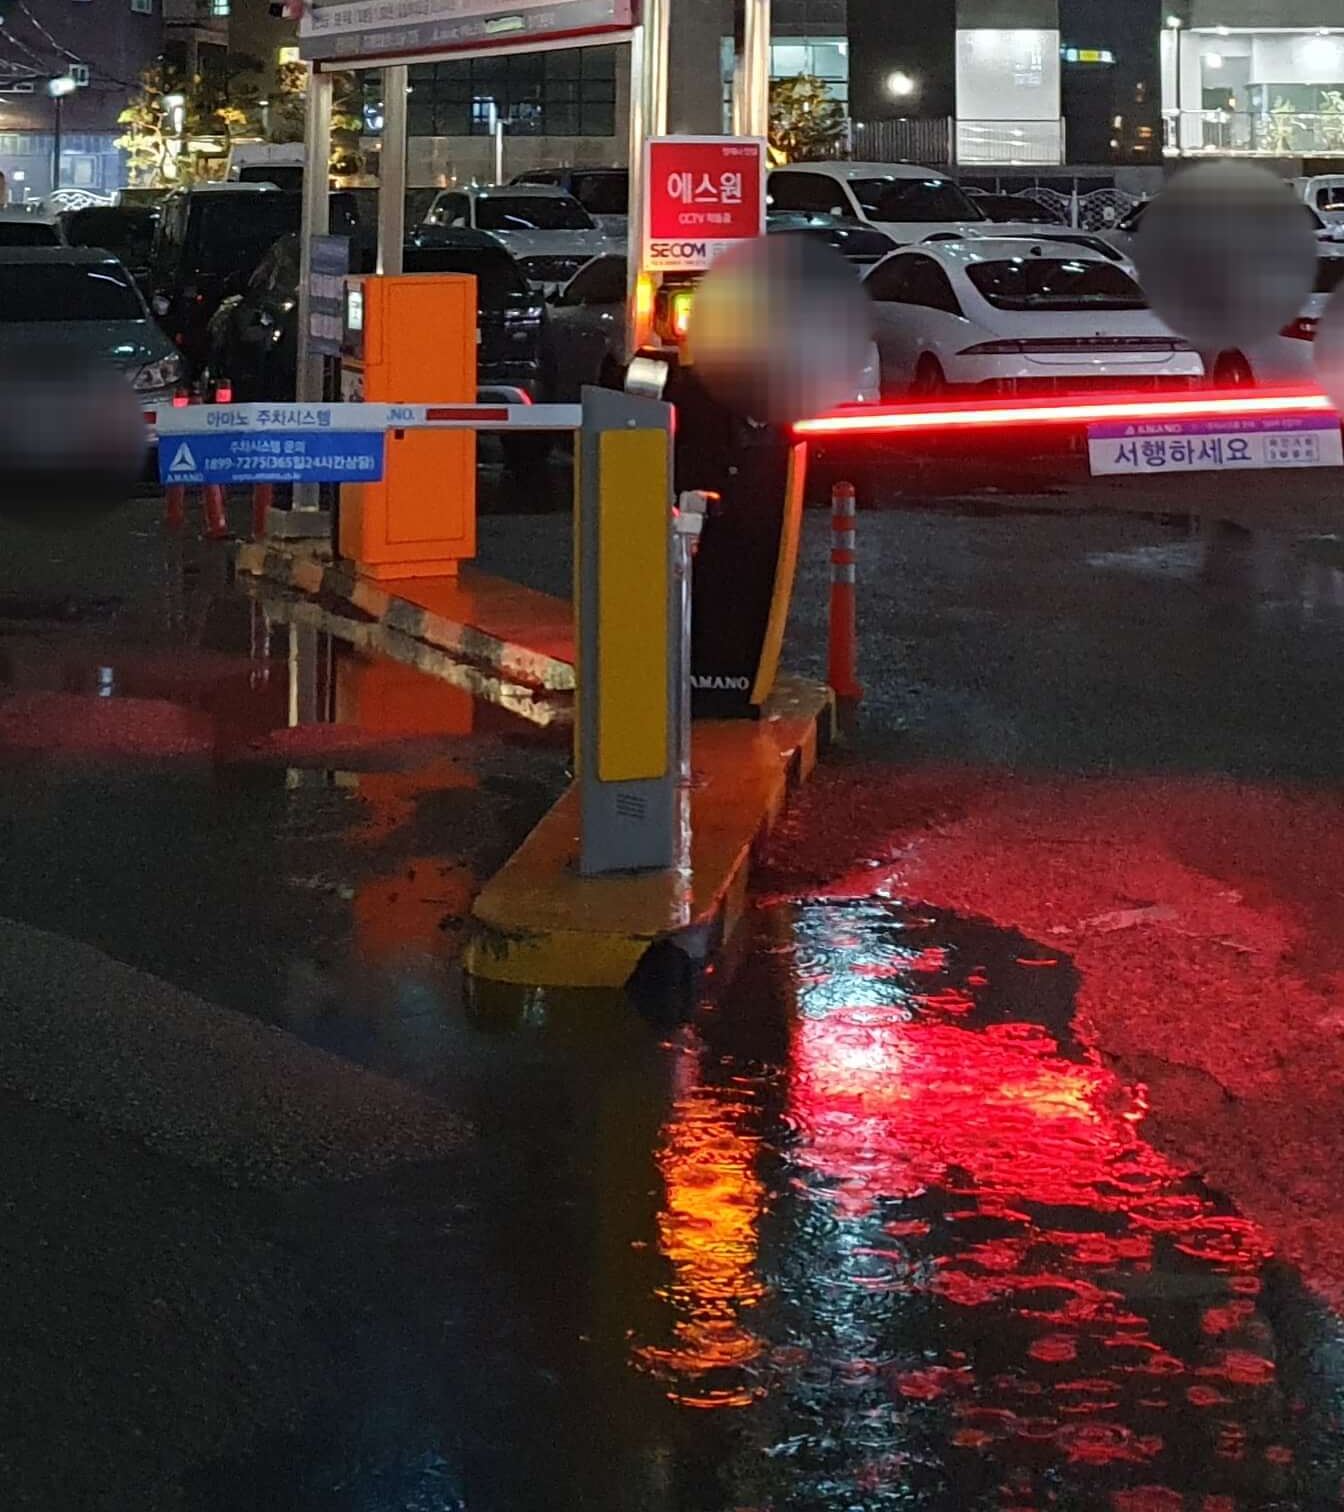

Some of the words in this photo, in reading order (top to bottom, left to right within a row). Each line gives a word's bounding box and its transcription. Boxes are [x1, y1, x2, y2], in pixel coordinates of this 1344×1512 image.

[667, 172, 743, 204] 에스원
[650, 243, 706, 258] SECOM
[255, 409, 331, 426] 주차시스템
[1114, 437, 1252, 467] 서행하세요
[690, 675, 750, 690] AMANO
